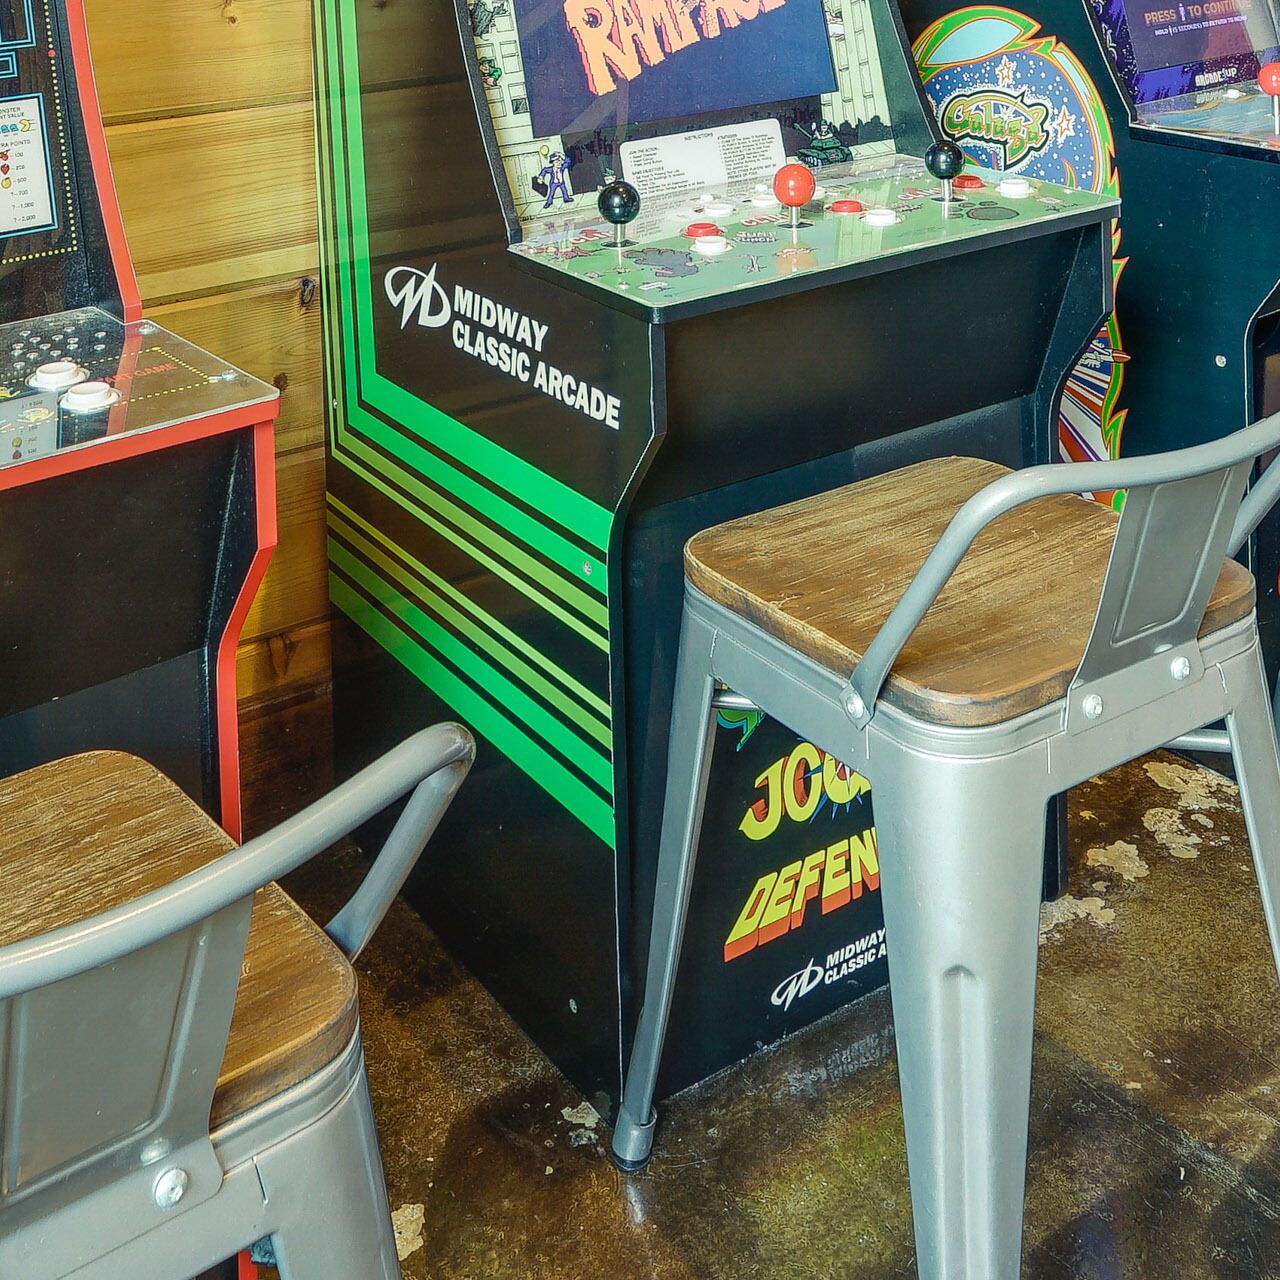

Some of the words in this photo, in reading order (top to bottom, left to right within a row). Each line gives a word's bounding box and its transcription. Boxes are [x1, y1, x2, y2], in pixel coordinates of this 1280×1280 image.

[1144, 9, 1177, 25] PRESS
[1187, 5, 1202, 18] TO
[945, 95, 1046, 162] Galaga
[453, 284, 549, 352] MIDWAY
[452, 320, 532, 383] CLASSIC
[533, 361, 621, 430] ARCADE
[738, 742, 872, 841] JOU
[724, 827, 880, 962] DEFEN
[824, 951, 876, 985] CLASSIC
[825, 927, 886, 969] MIDWAY
